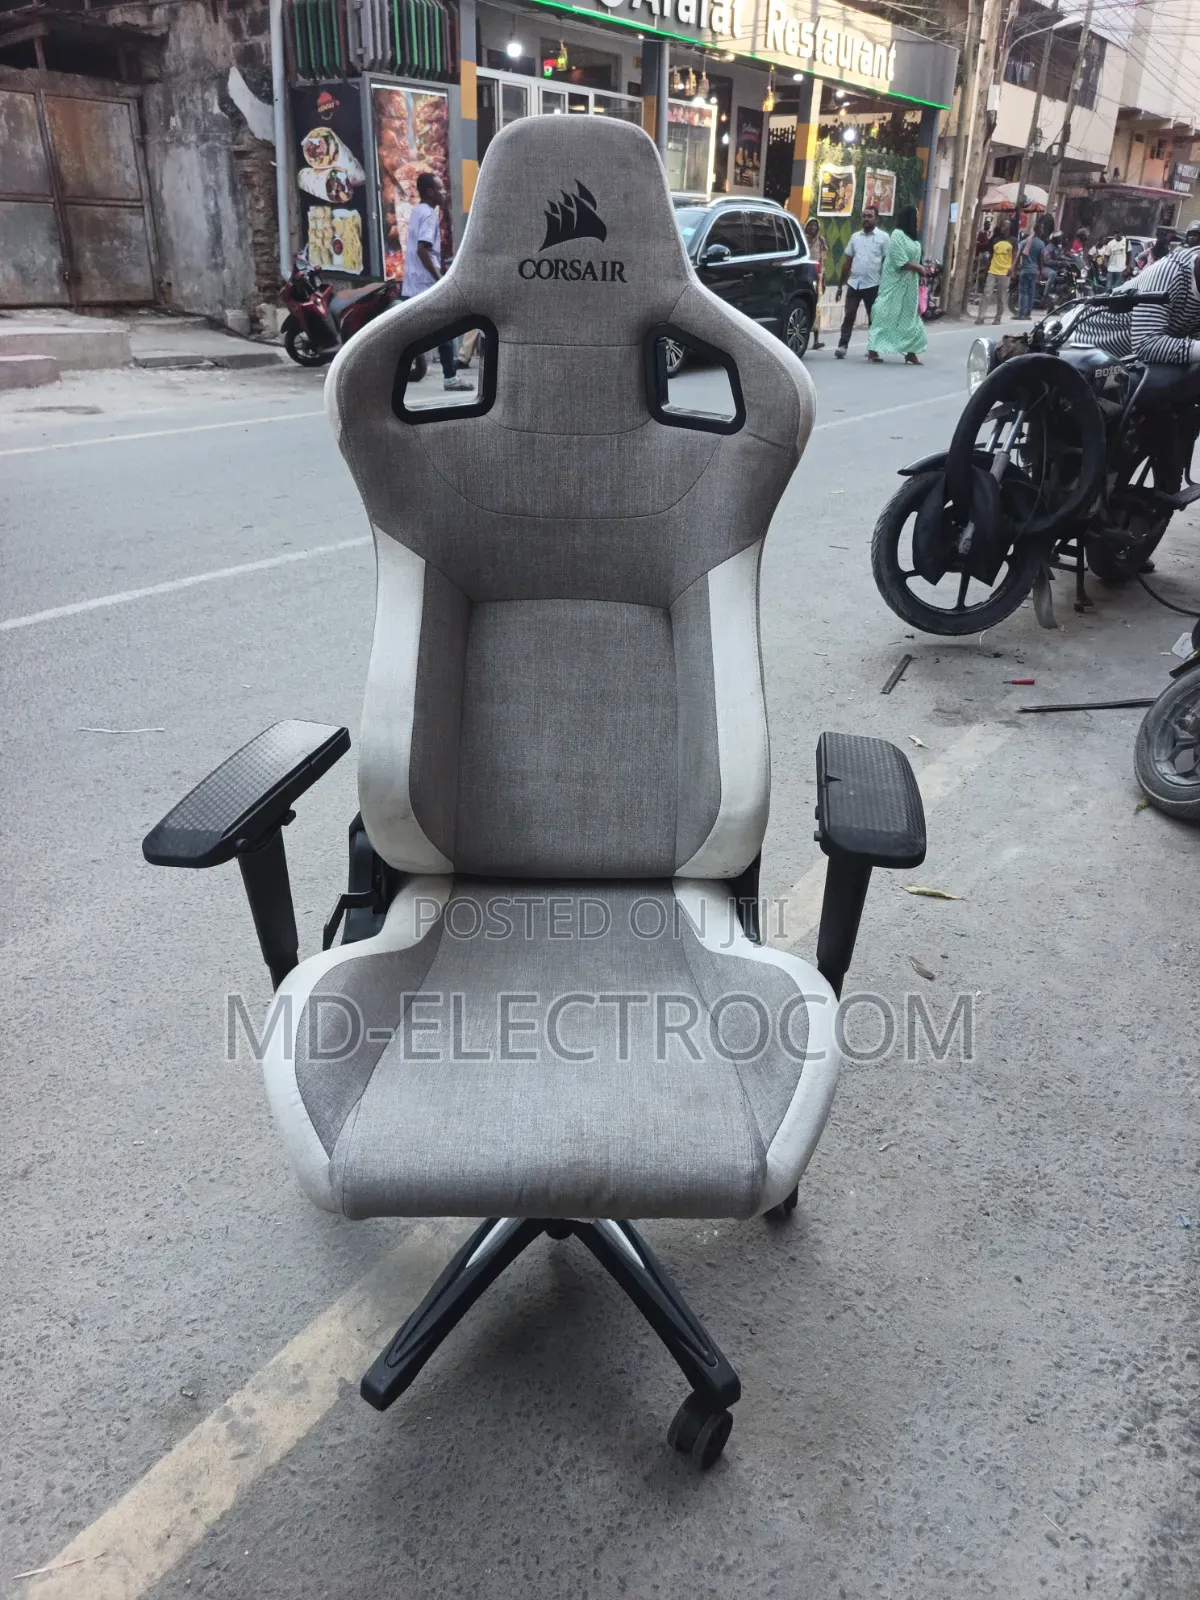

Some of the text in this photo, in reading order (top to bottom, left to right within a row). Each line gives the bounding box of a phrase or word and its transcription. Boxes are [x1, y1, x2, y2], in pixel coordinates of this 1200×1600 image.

[632, 0, 897, 81] aat Restaurant
[518, 259, 627, 283] CORSAIR
[1095, 366, 1122, 378] BOXE
